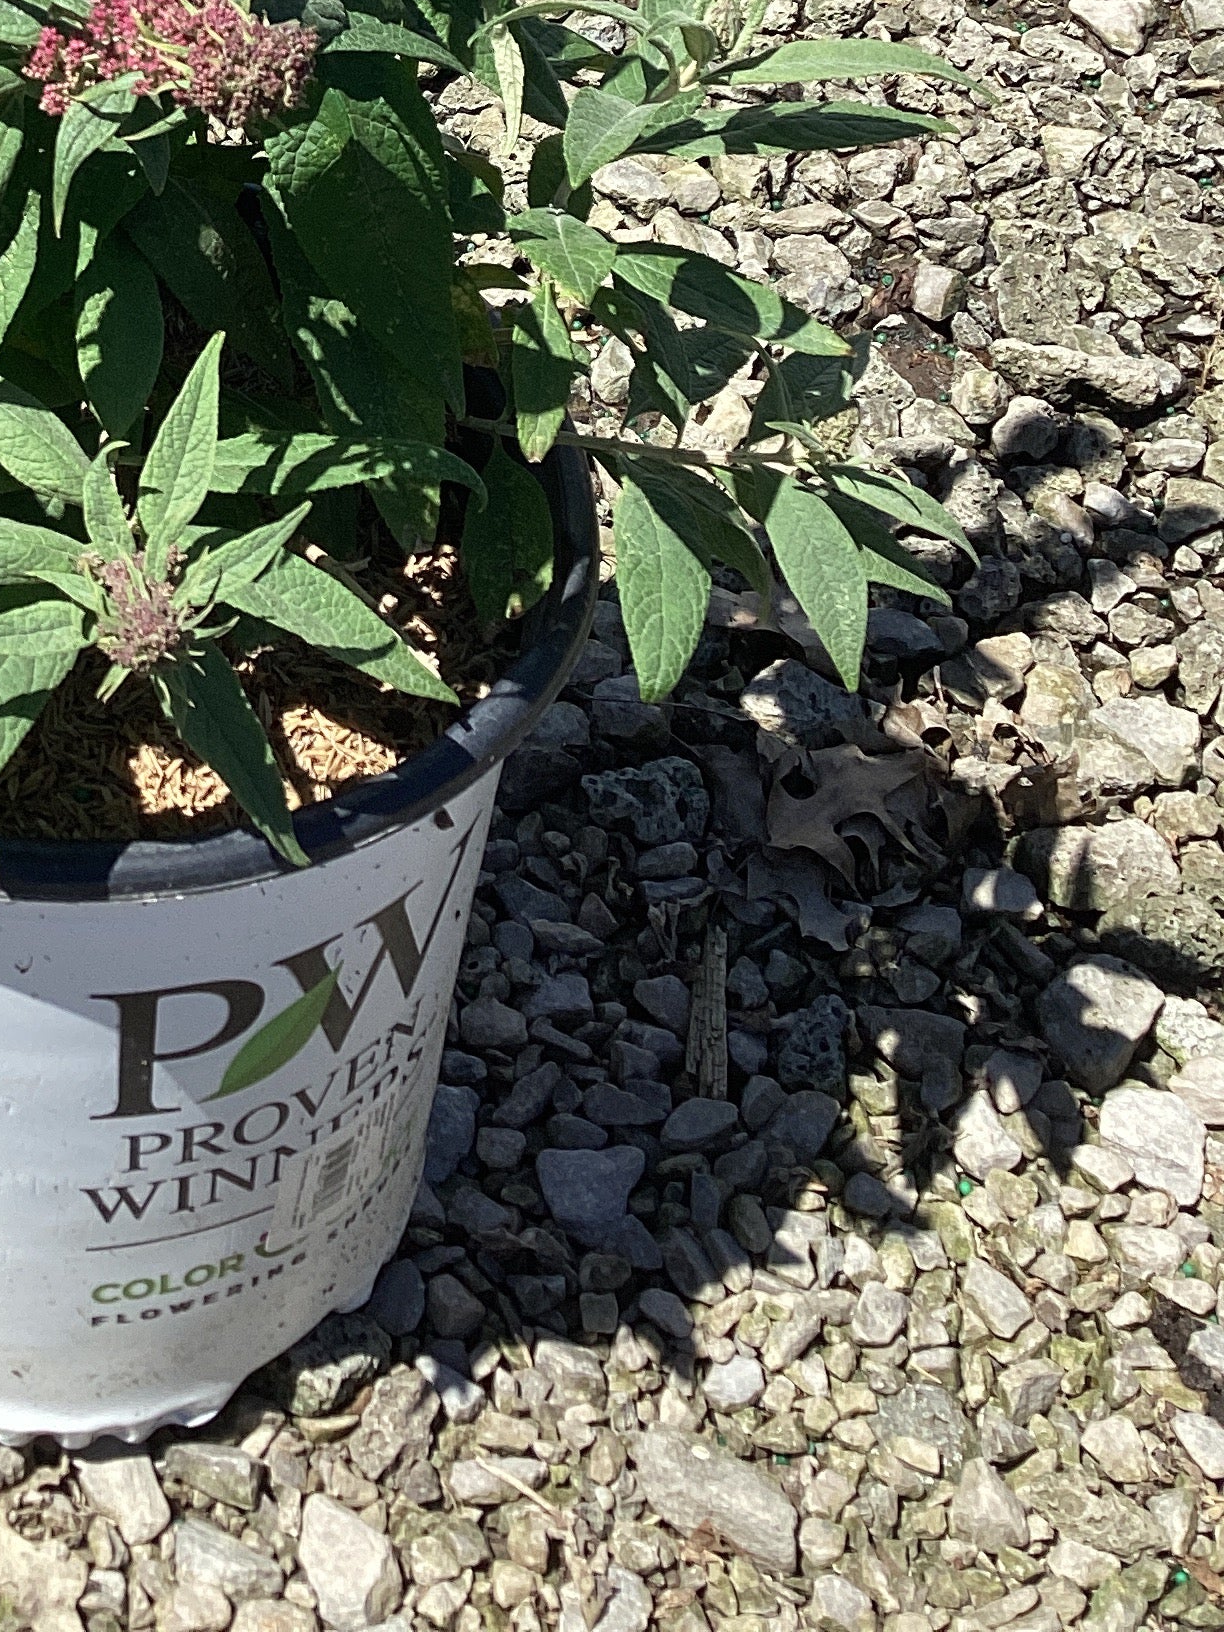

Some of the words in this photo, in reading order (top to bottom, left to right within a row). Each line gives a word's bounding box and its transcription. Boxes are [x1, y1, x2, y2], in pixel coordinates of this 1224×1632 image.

[89, 808, 483, 1120] PW
[121, 992, 425, 1174] PROVEN
[90, 1251, 246, 1305] COLOR
[90, 1252, 307, 1328] FLOWERING
